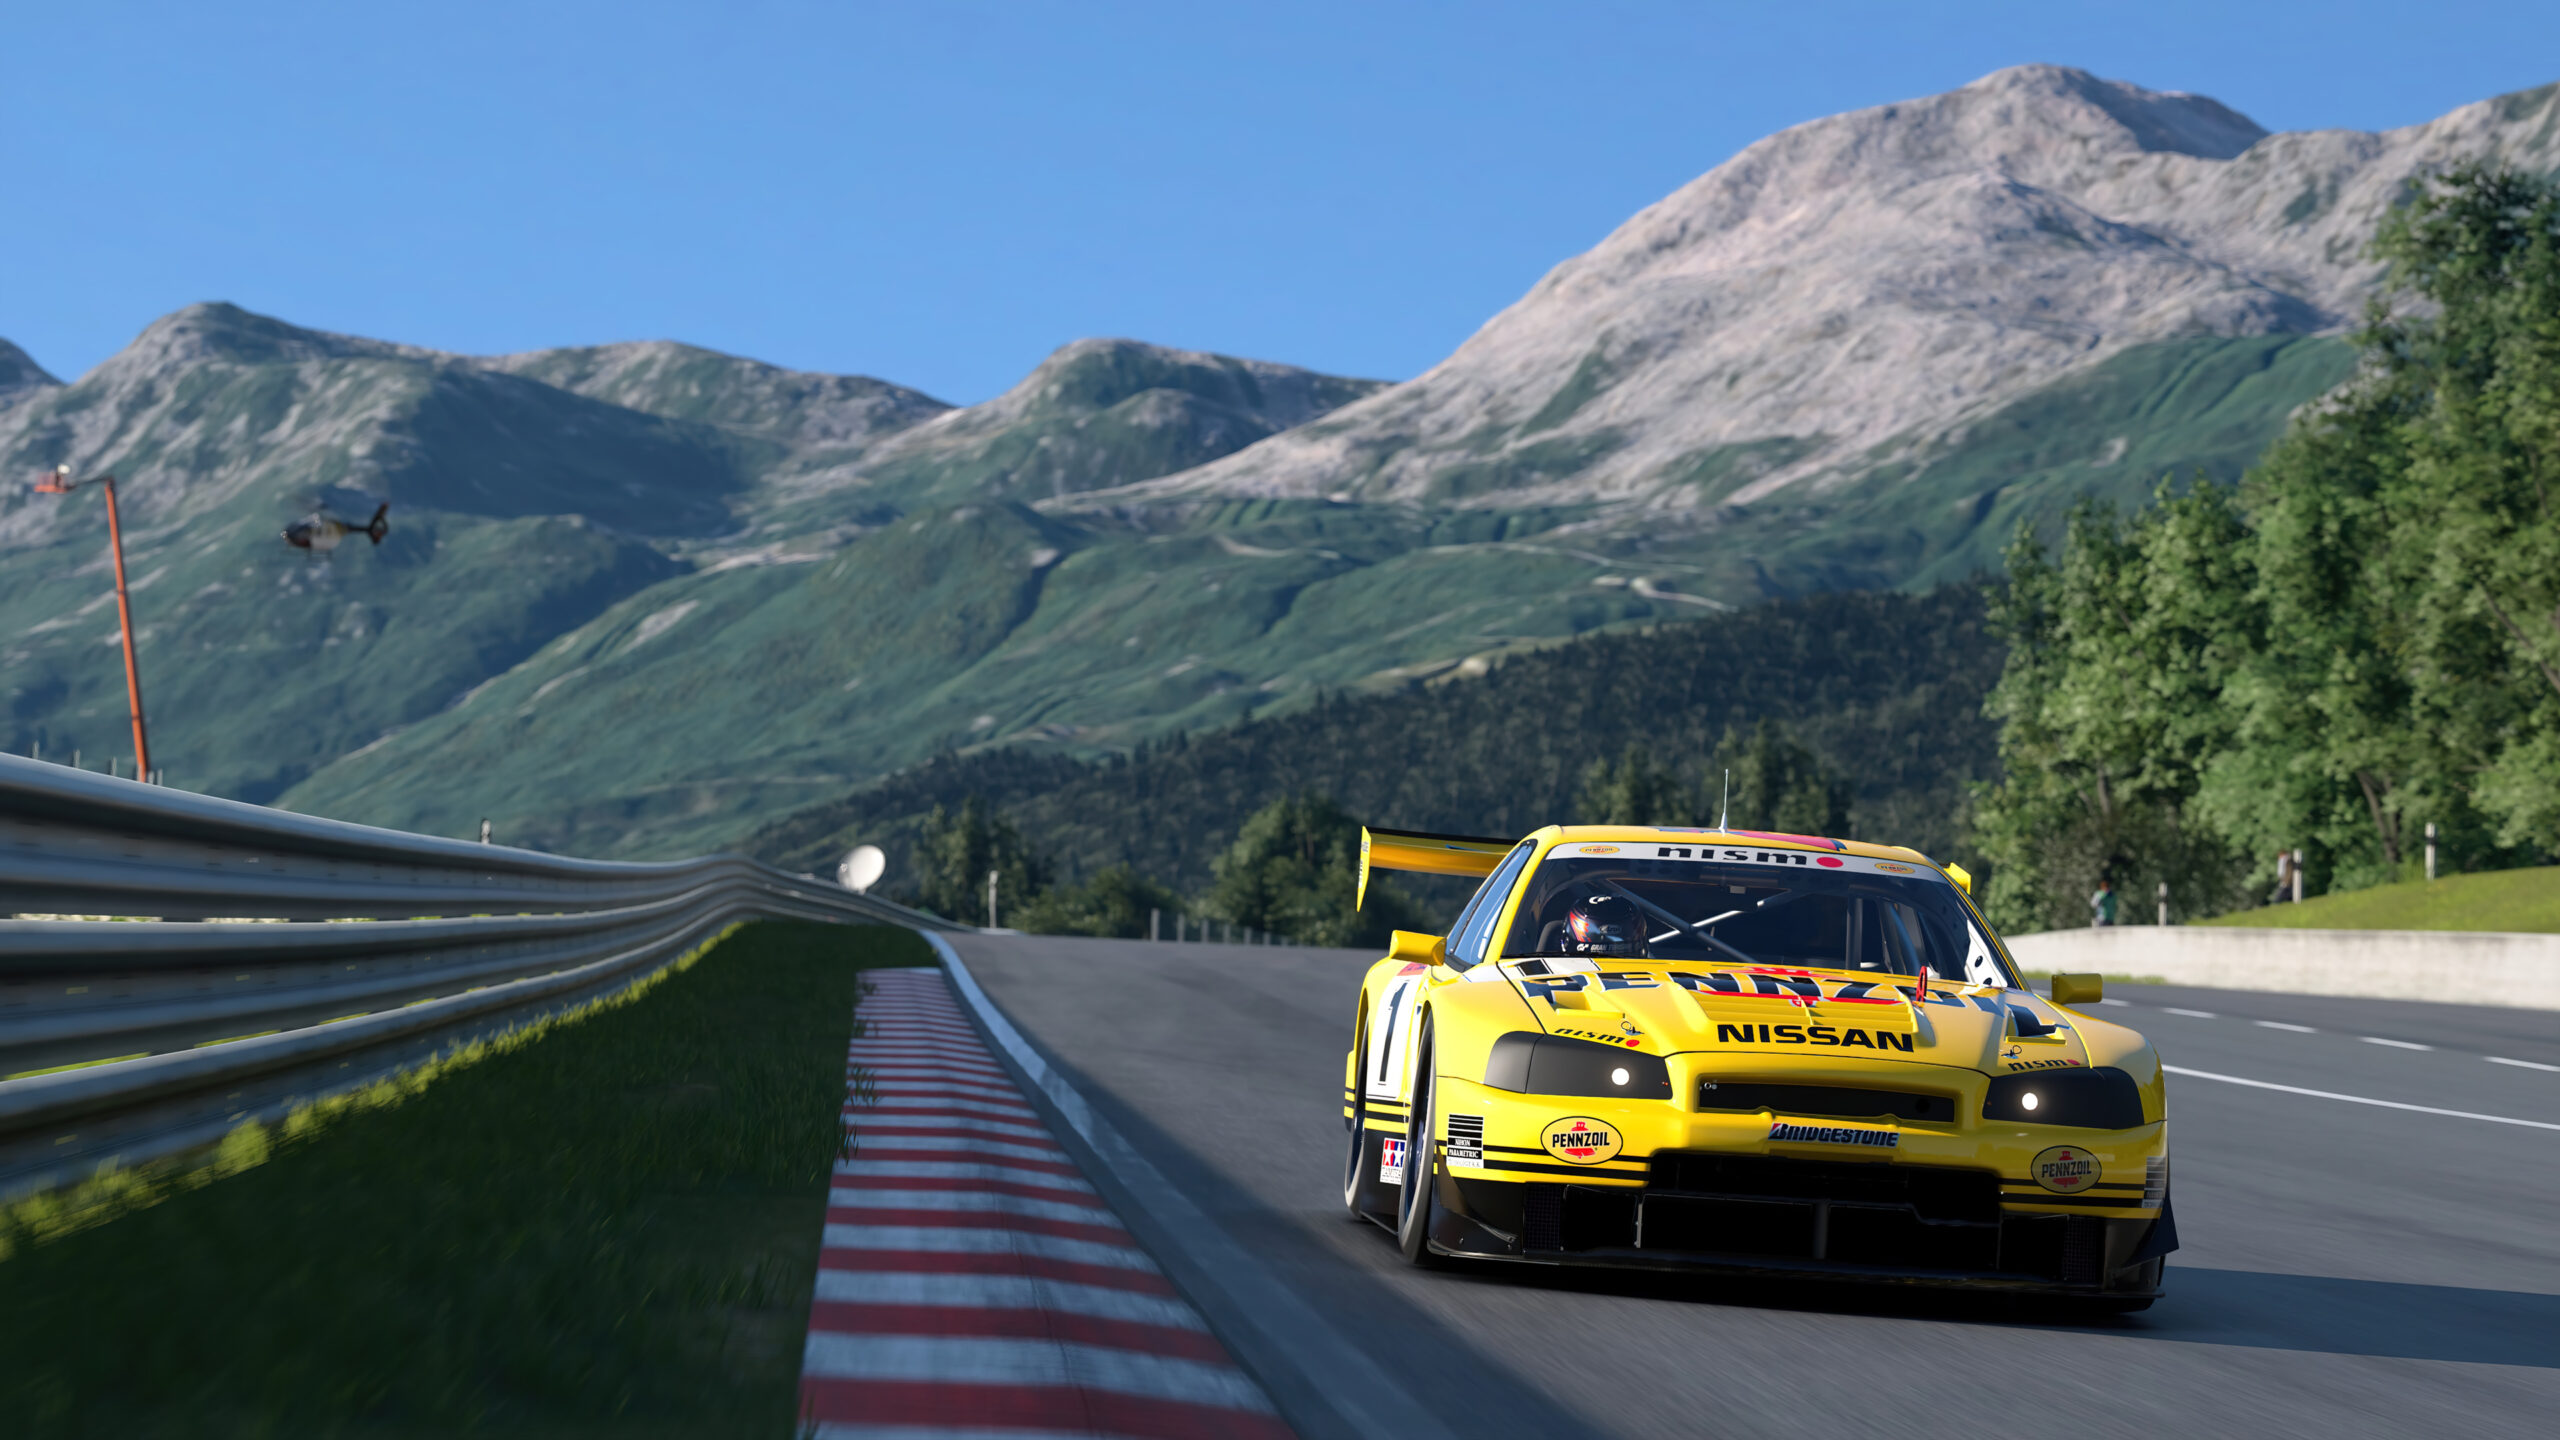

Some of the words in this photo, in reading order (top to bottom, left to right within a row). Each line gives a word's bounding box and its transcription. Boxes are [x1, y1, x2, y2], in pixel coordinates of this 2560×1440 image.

[1377, 979, 1409, 1086] 1
[1716, 1023, 1914, 1053] NISSAN
[1551, 1130, 1611, 1148] PENNZOIL
[1769, 1122, 1900, 1148] BRIDGESTONE
[2041, 1159, 2093, 1178] PENNZOIL
